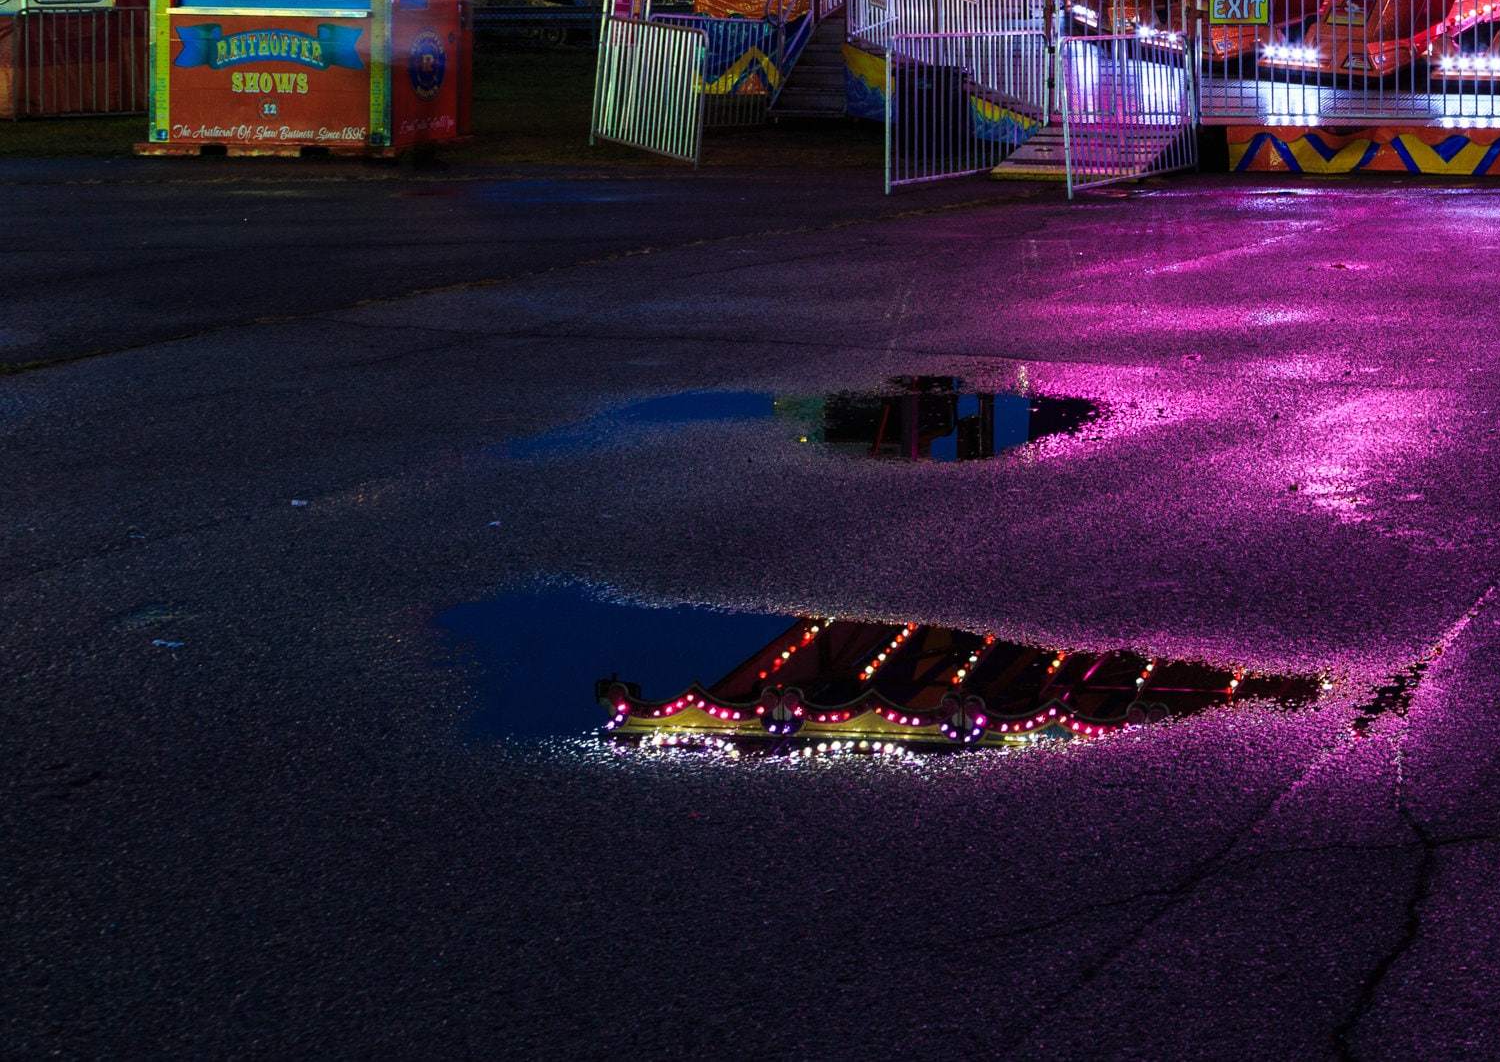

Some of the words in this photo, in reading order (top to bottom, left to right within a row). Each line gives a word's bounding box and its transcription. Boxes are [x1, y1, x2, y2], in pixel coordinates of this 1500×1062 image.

[216, 32, 324, 67] REITHOFFER
[231, 71, 309, 94] SHOWS
[263, 103, 277, 114] 12
[172, 124, 191, 138] The
[192, 124, 236, 139] Aristocrat
[237, 125, 251, 143] Of
[253, 126, 278, 141] Show
[279, 126, 314, 141] Business
[315, 127, 340, 142] Since
[341, 127, 367, 140] 1896
